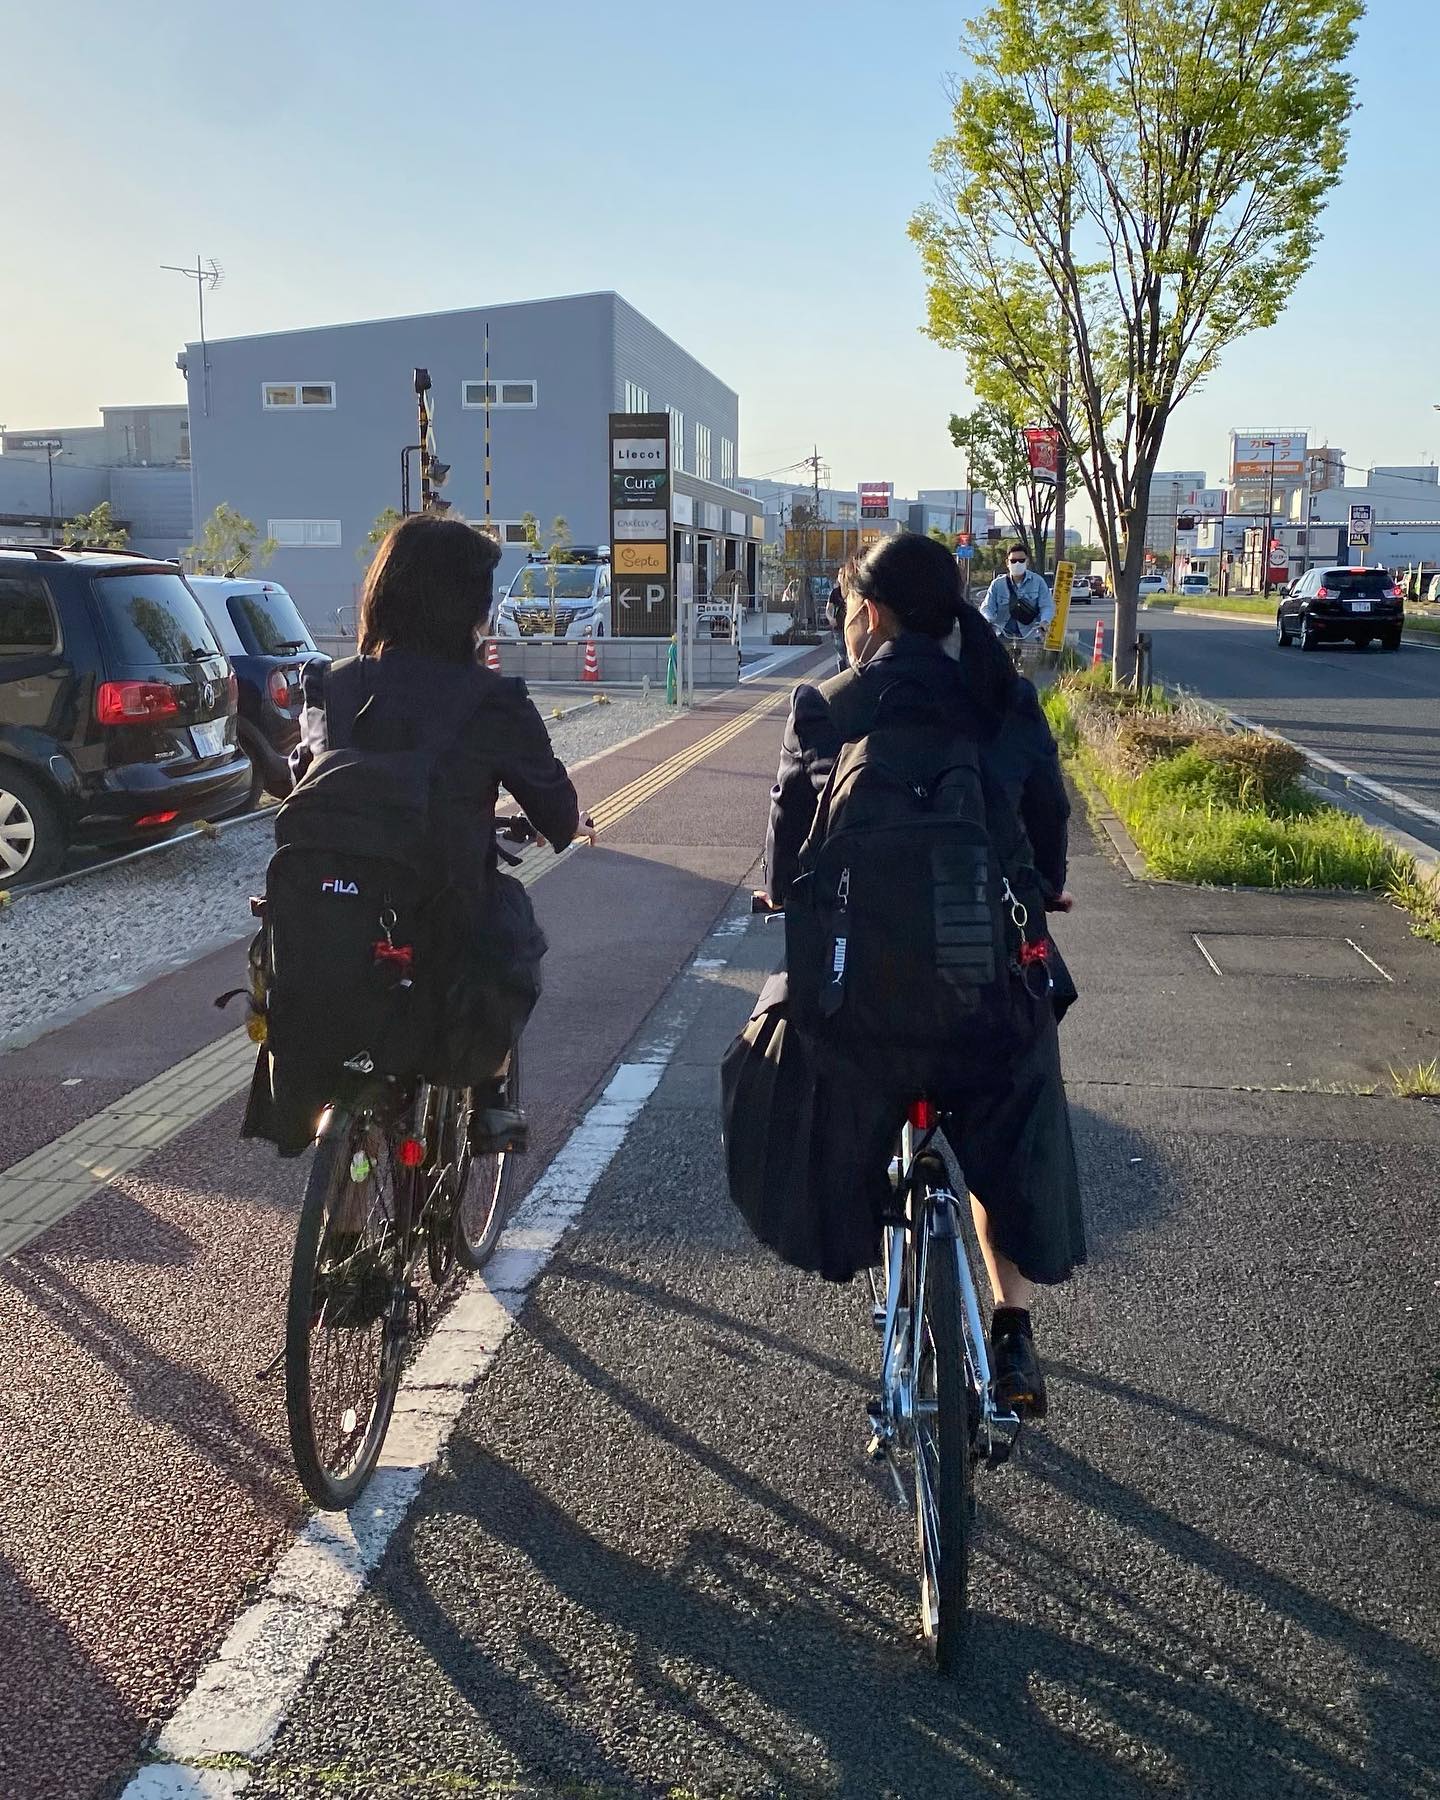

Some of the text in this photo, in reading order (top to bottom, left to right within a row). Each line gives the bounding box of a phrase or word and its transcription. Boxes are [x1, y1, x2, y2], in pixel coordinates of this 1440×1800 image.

[624, 475, 656, 489] Cura
[621, 548, 660, 568] Septo
[647, 584, 665, 613] P
[322, 879, 358, 895] FILA
[834, 937, 846, 971] PUMA
